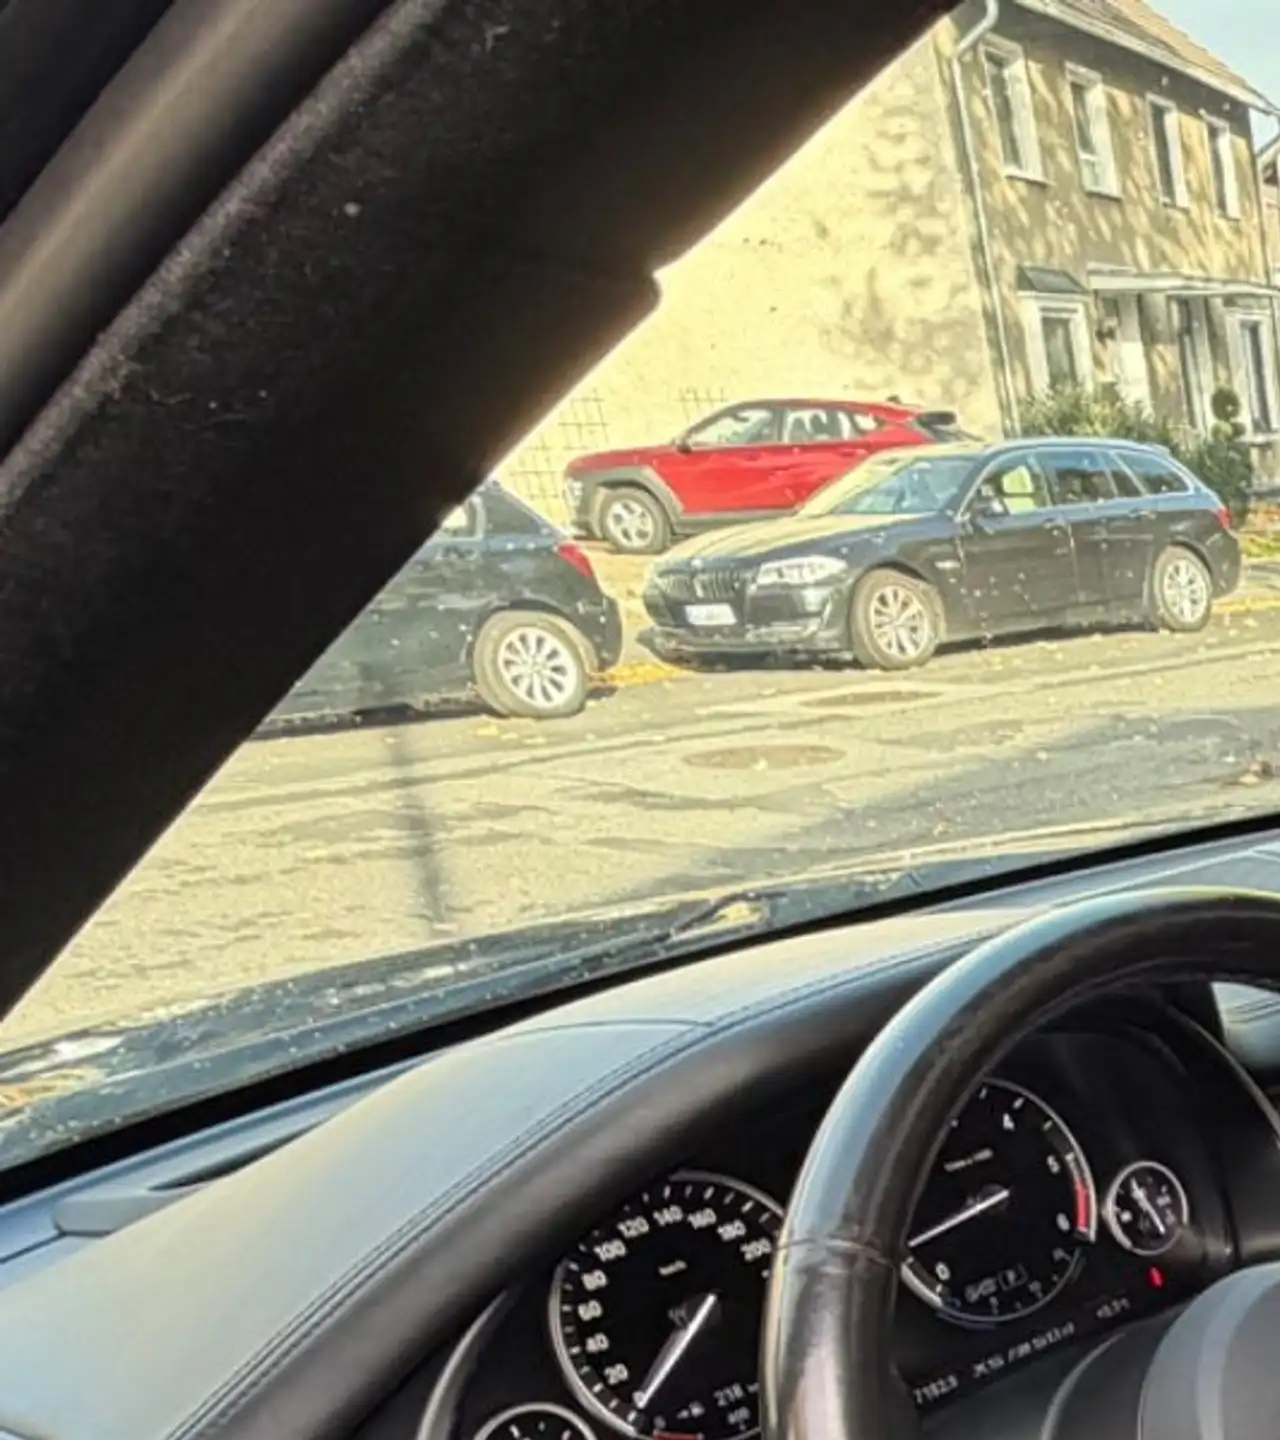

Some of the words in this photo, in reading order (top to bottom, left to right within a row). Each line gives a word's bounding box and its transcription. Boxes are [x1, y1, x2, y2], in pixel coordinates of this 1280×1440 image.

[1001, 1112, 1016, 1132] 4
[1046, 1154, 1060, 1174] 5
[654, 1204, 684, 1227] 140
[688, 1208, 717, 1229] 160
[1056, 1212, 1070, 1231] 6
[618, 1216, 650, 1239] 120
[717, 1219, 747, 1242] 180
[594, 1239, 628, 1262] 100
[740, 1238, 772, 1263] 200
[581, 1269, 609, 1292] 80
[936, 1261, 951, 1281] 0
[577, 1300, 604, 1322] 60
[585, 1332, 610, 1353] 40
[604, 1363, 630, 1385] 20
